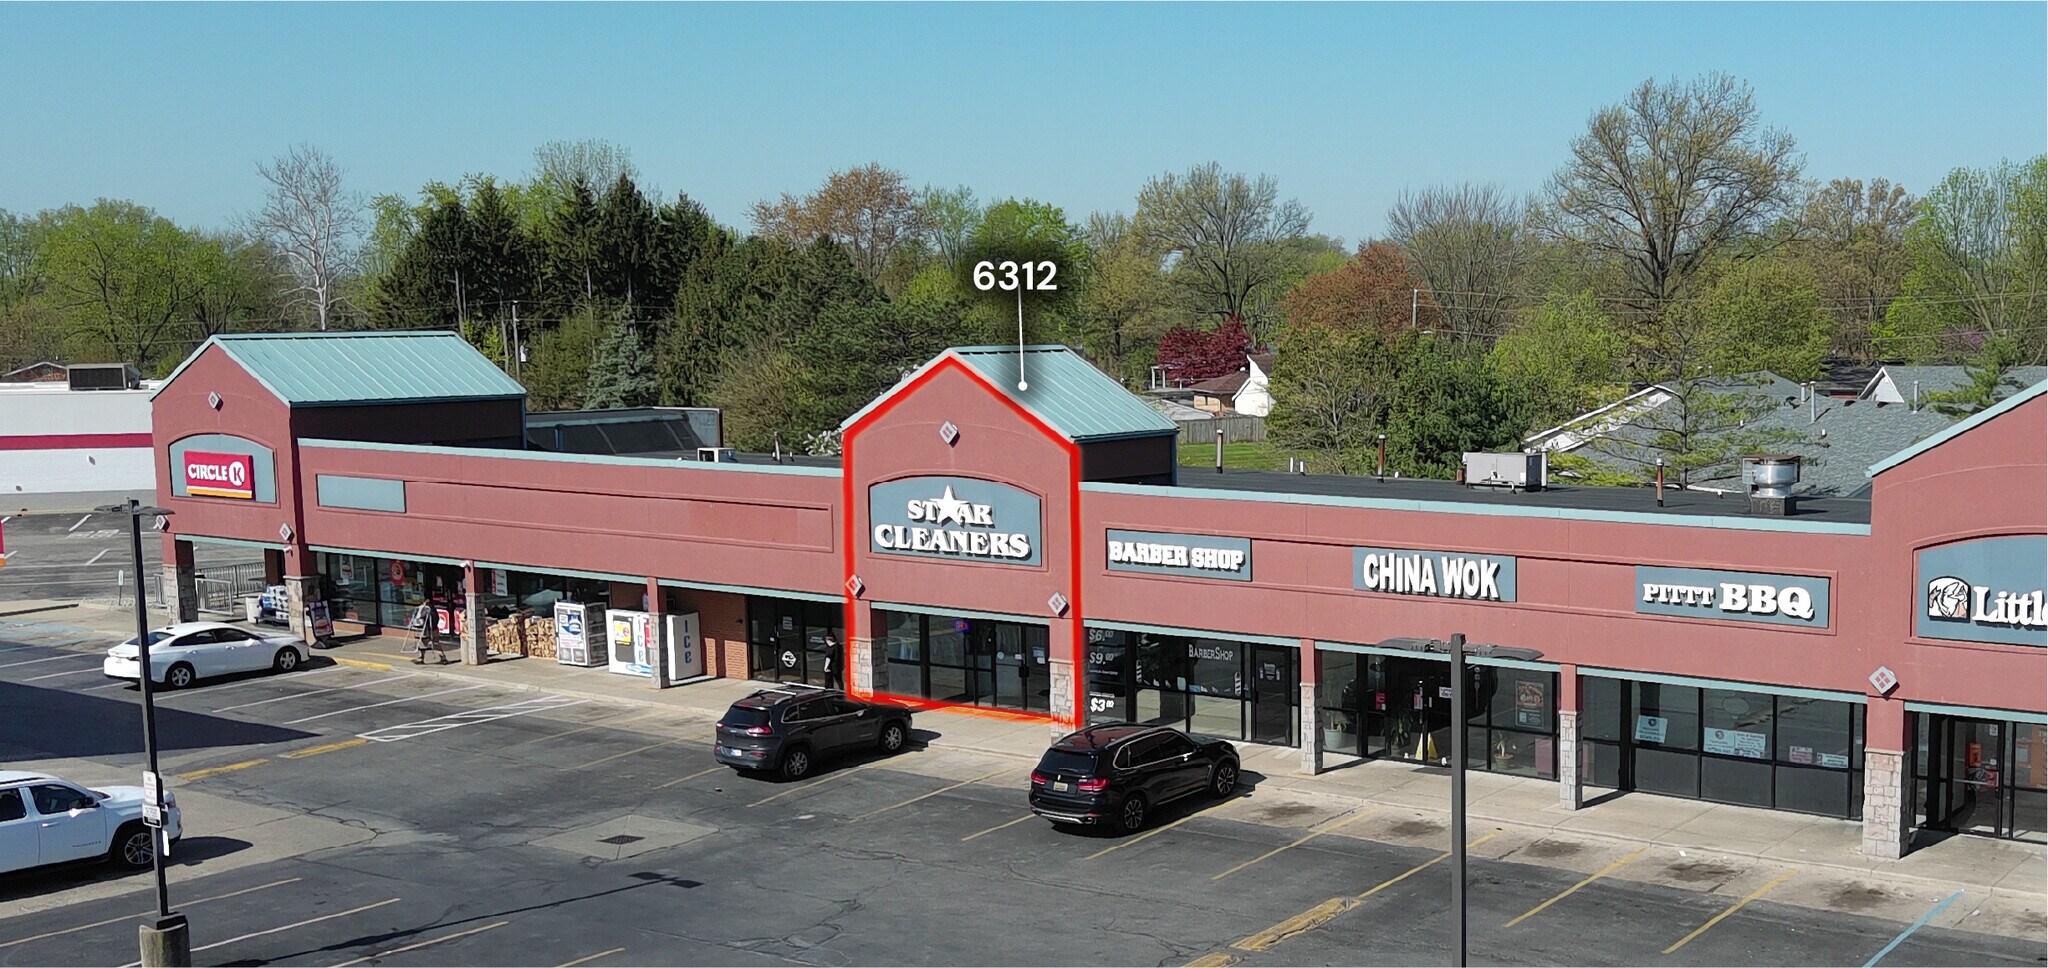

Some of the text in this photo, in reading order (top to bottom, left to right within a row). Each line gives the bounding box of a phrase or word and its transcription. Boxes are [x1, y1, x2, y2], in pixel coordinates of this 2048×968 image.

[187, 463, 243, 484] CIRCLE K
[907, 494, 993, 526] STAR
[874, 524, 1030, 558] CLEANERS
[1108, 540, 1244, 571] BARBER SHOP
[1363, 552, 1499, 598] CHINA WOK
[1642, 583, 1814, 619] PITTT BBQ
[1972, 586, 2047, 626] Littl
